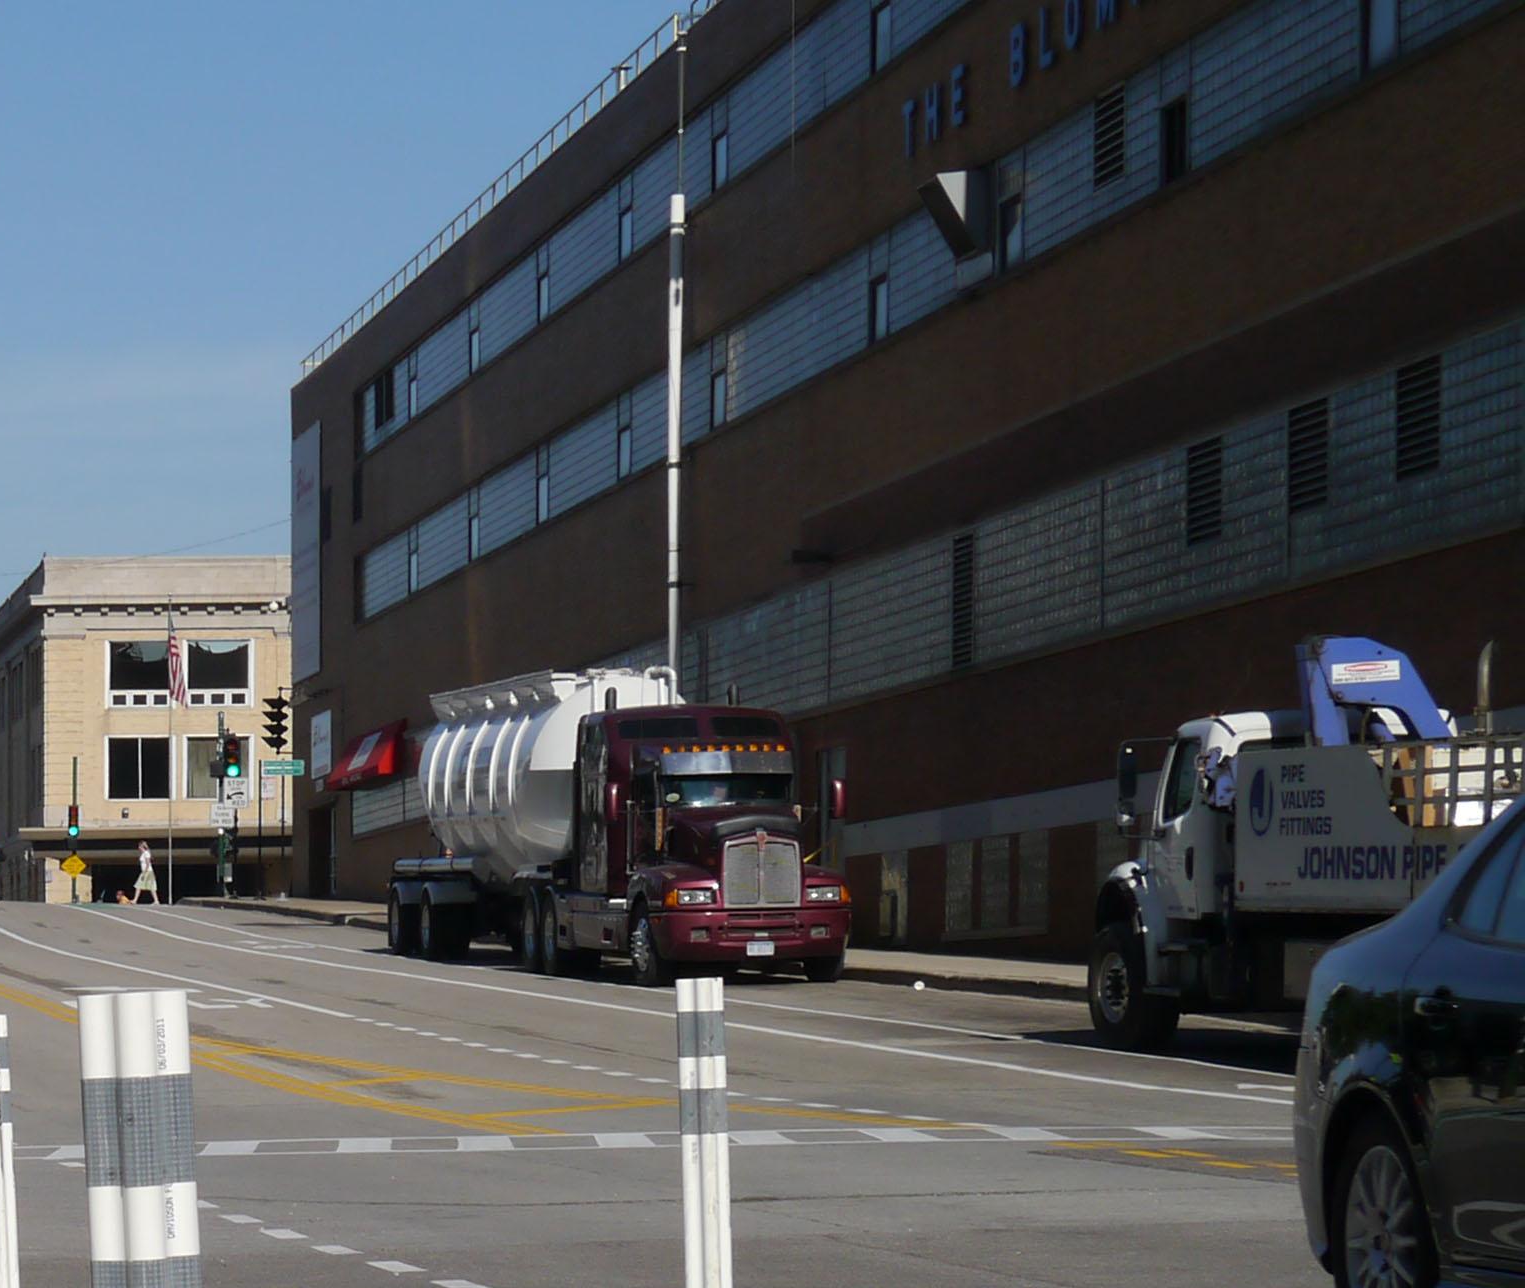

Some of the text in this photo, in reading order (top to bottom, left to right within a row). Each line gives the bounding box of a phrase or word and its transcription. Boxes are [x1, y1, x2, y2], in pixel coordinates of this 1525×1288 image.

[902, 0, 1139, 159] THE BLO
[1281, 764, 1305, 783] PIPE
[1281, 790, 1325, 809] VALVES
[1280, 816, 1333, 836] FITTINGS
[1297, 845, 1397, 880] JOHNSON
